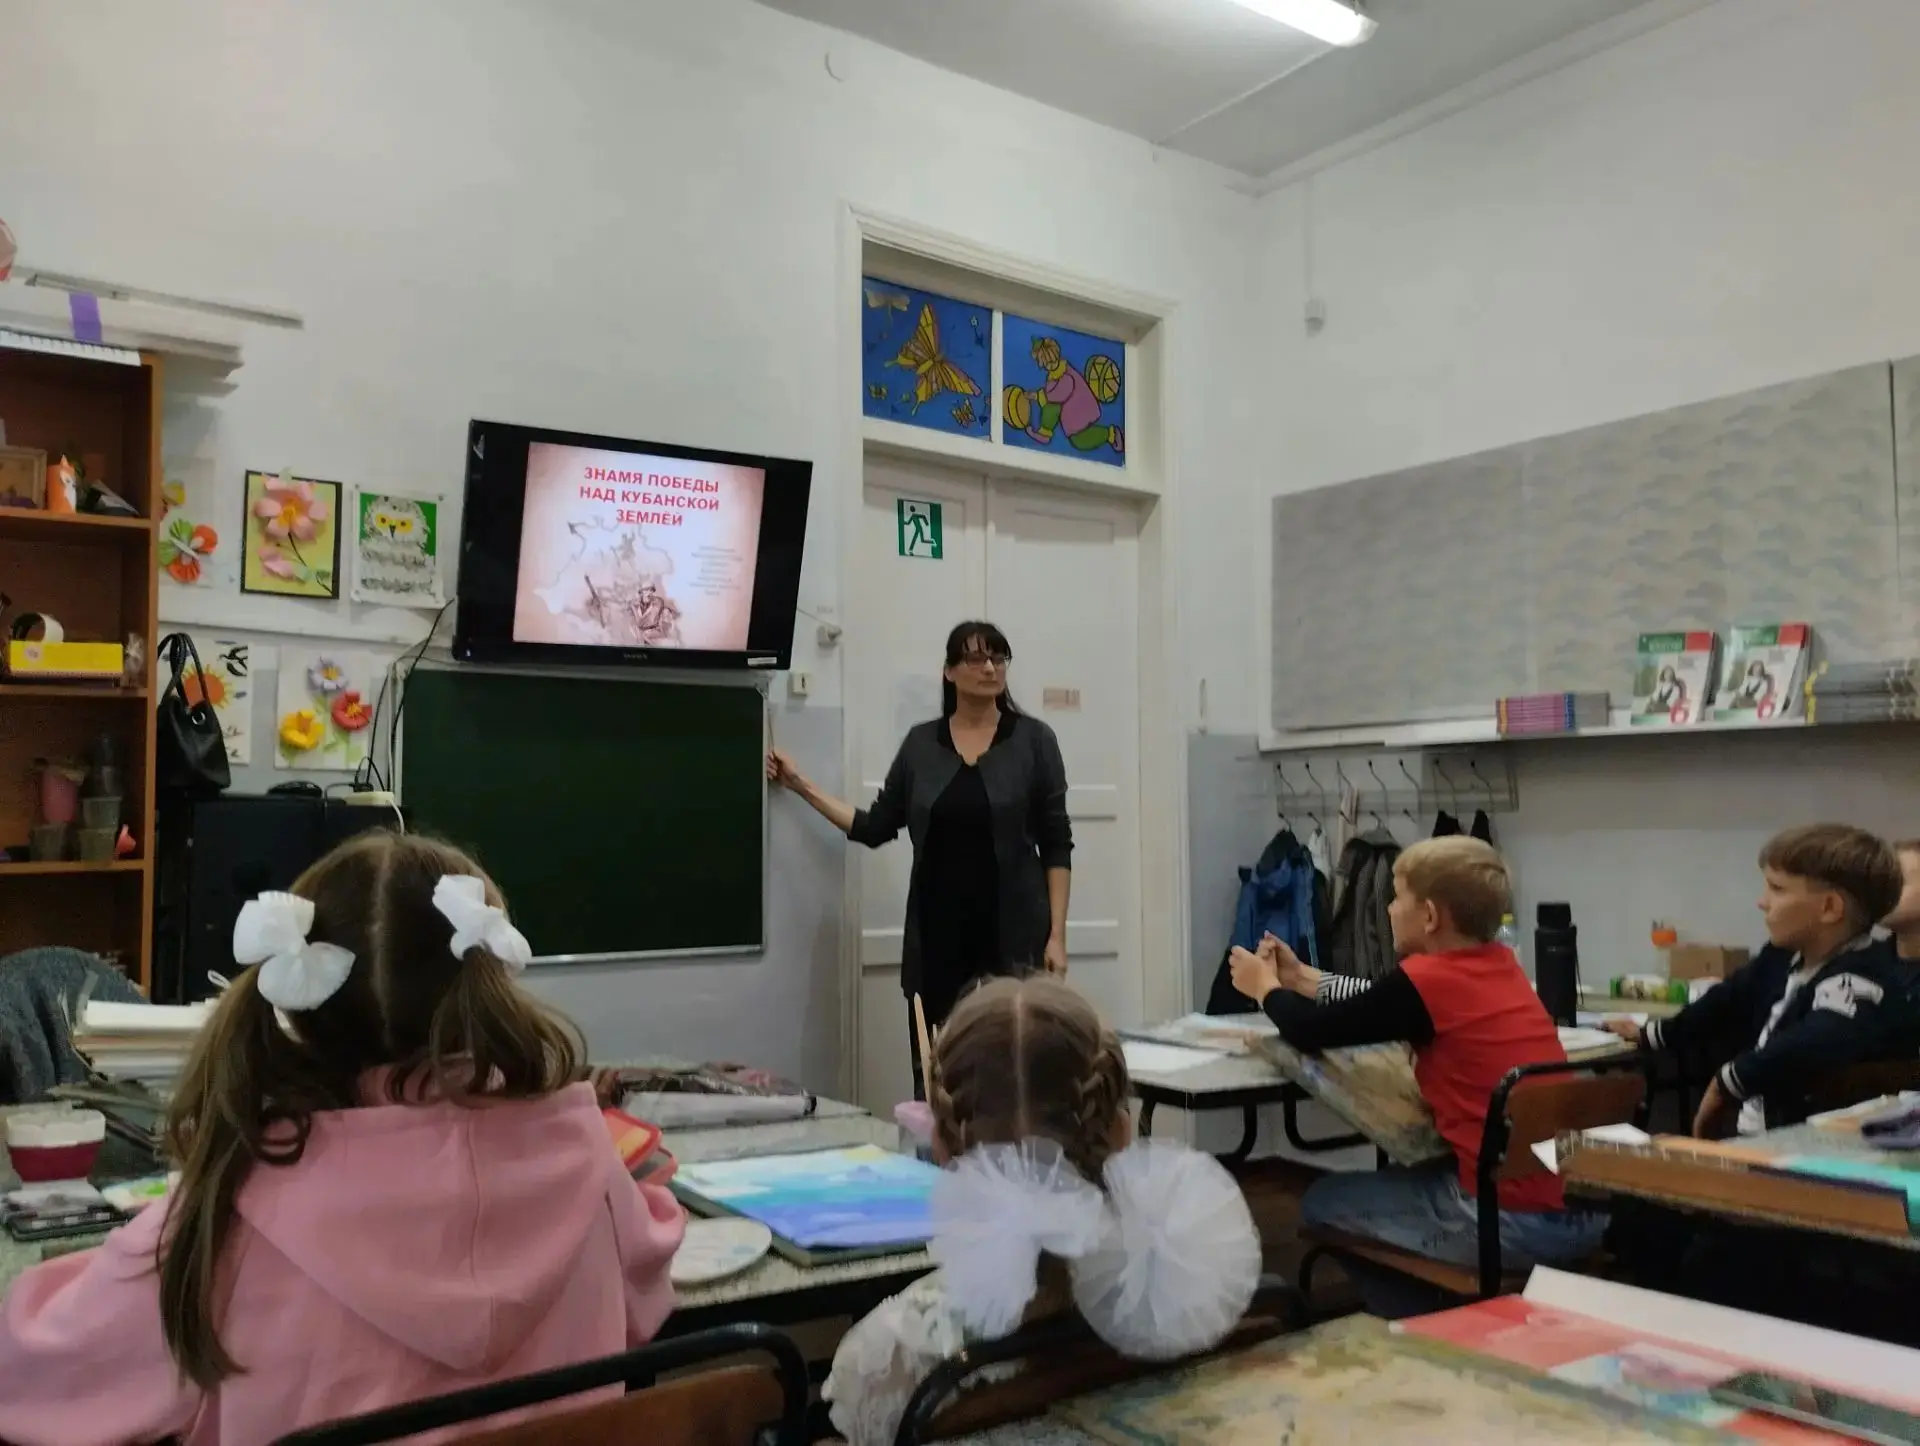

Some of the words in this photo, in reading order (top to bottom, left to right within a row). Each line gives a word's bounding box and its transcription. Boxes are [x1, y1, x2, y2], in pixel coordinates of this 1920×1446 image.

[584, 467, 643, 485] ЗНАМЯ
[648, 474, 719, 493] ПОБЕДЫ
[580, 486, 616, 503] НАД
[621, 490, 719, 510] КУБАНСКОЙ
